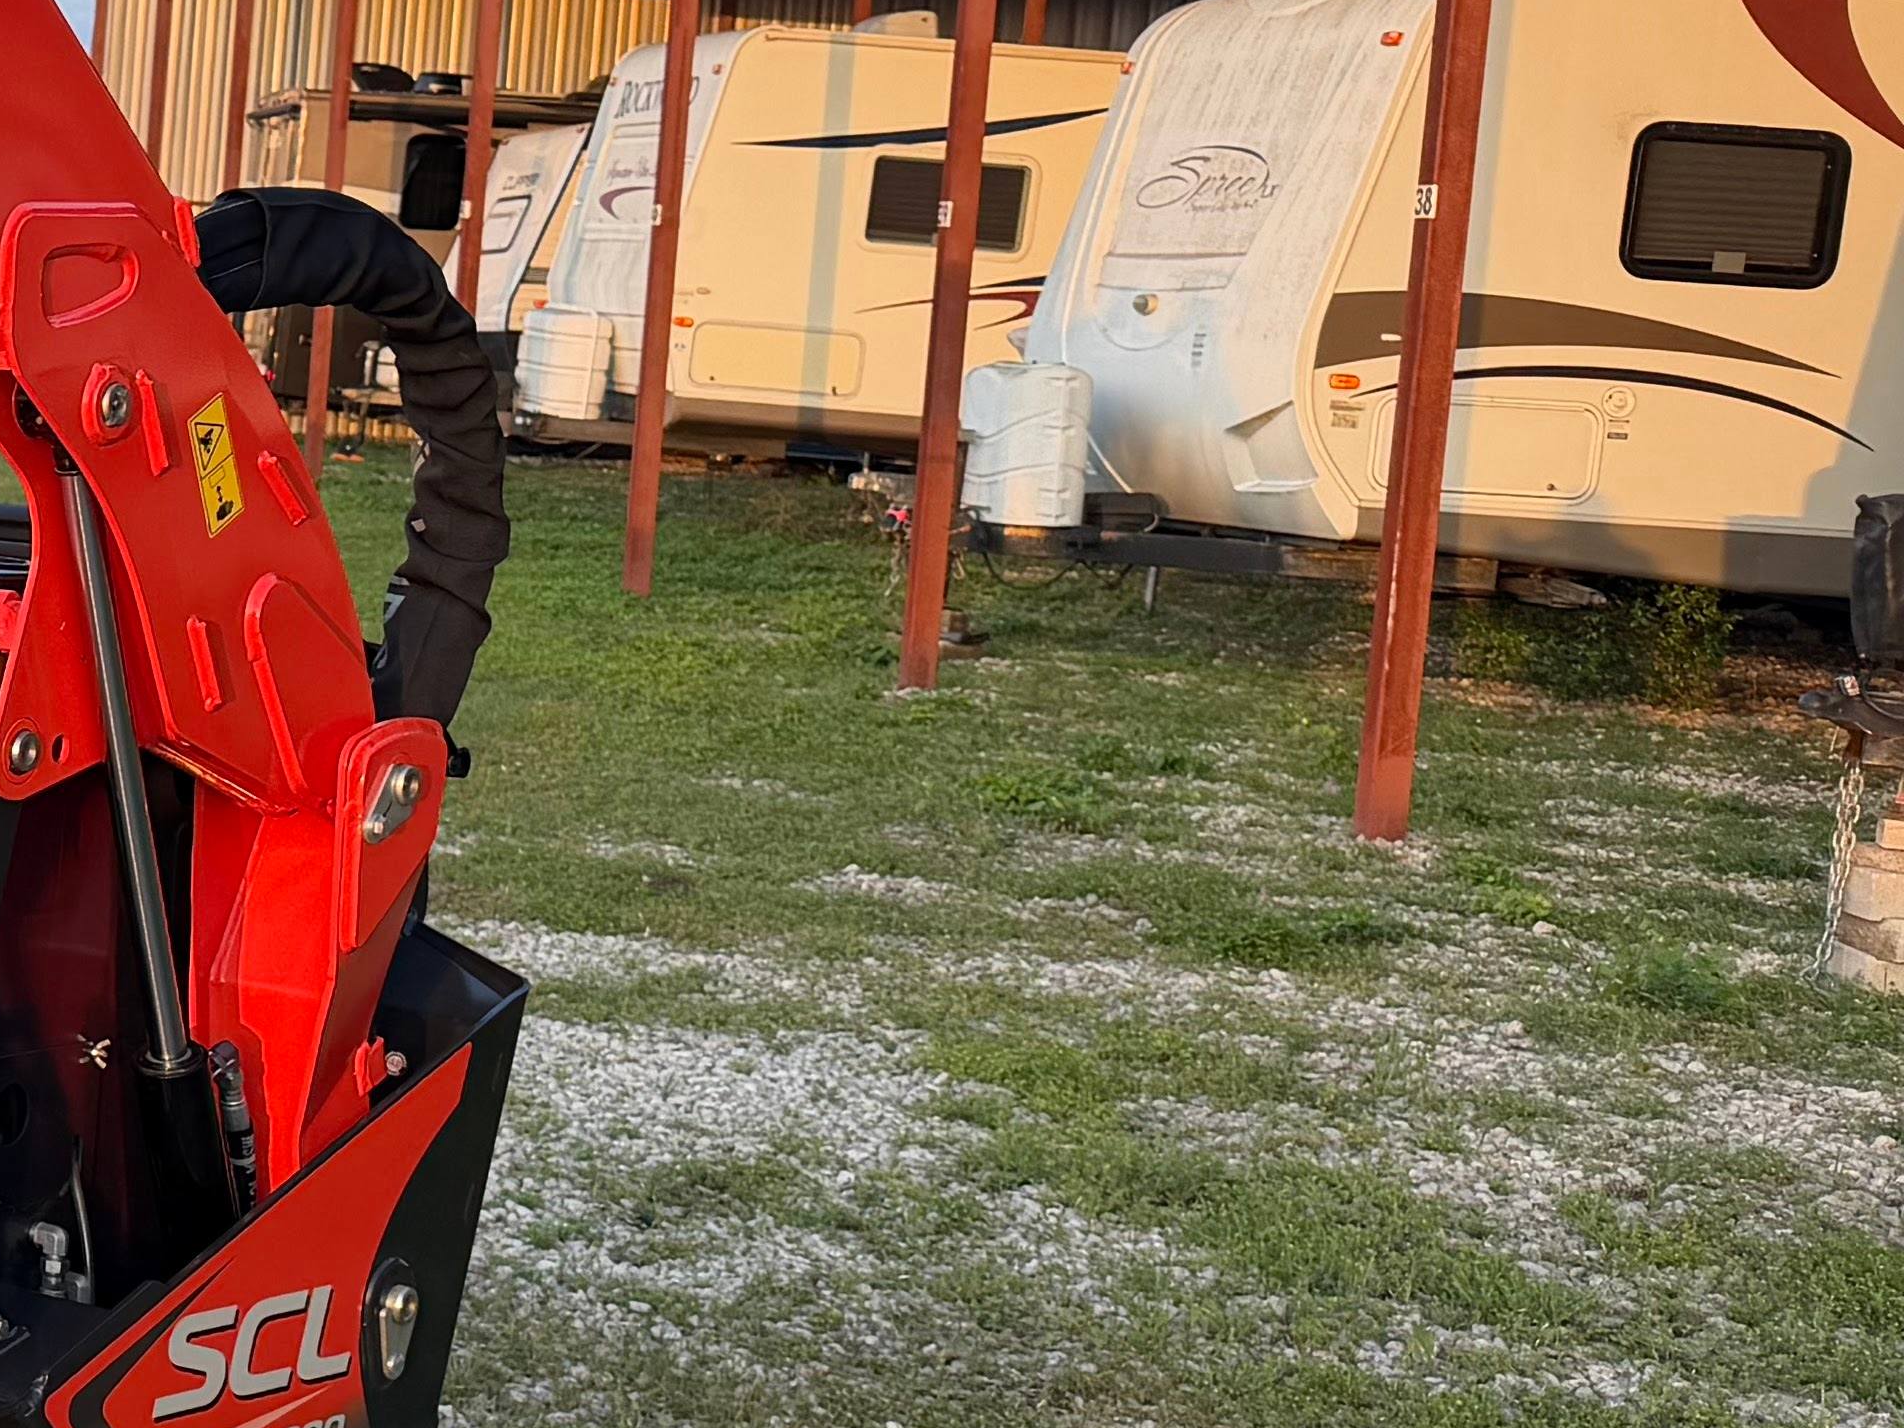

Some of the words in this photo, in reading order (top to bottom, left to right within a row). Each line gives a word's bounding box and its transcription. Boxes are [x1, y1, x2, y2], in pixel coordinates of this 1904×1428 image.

[1136, 156, 1259, 209] Spree
[1414, 187, 1433, 215] 38
[152, 1285, 351, 1422] SCL
